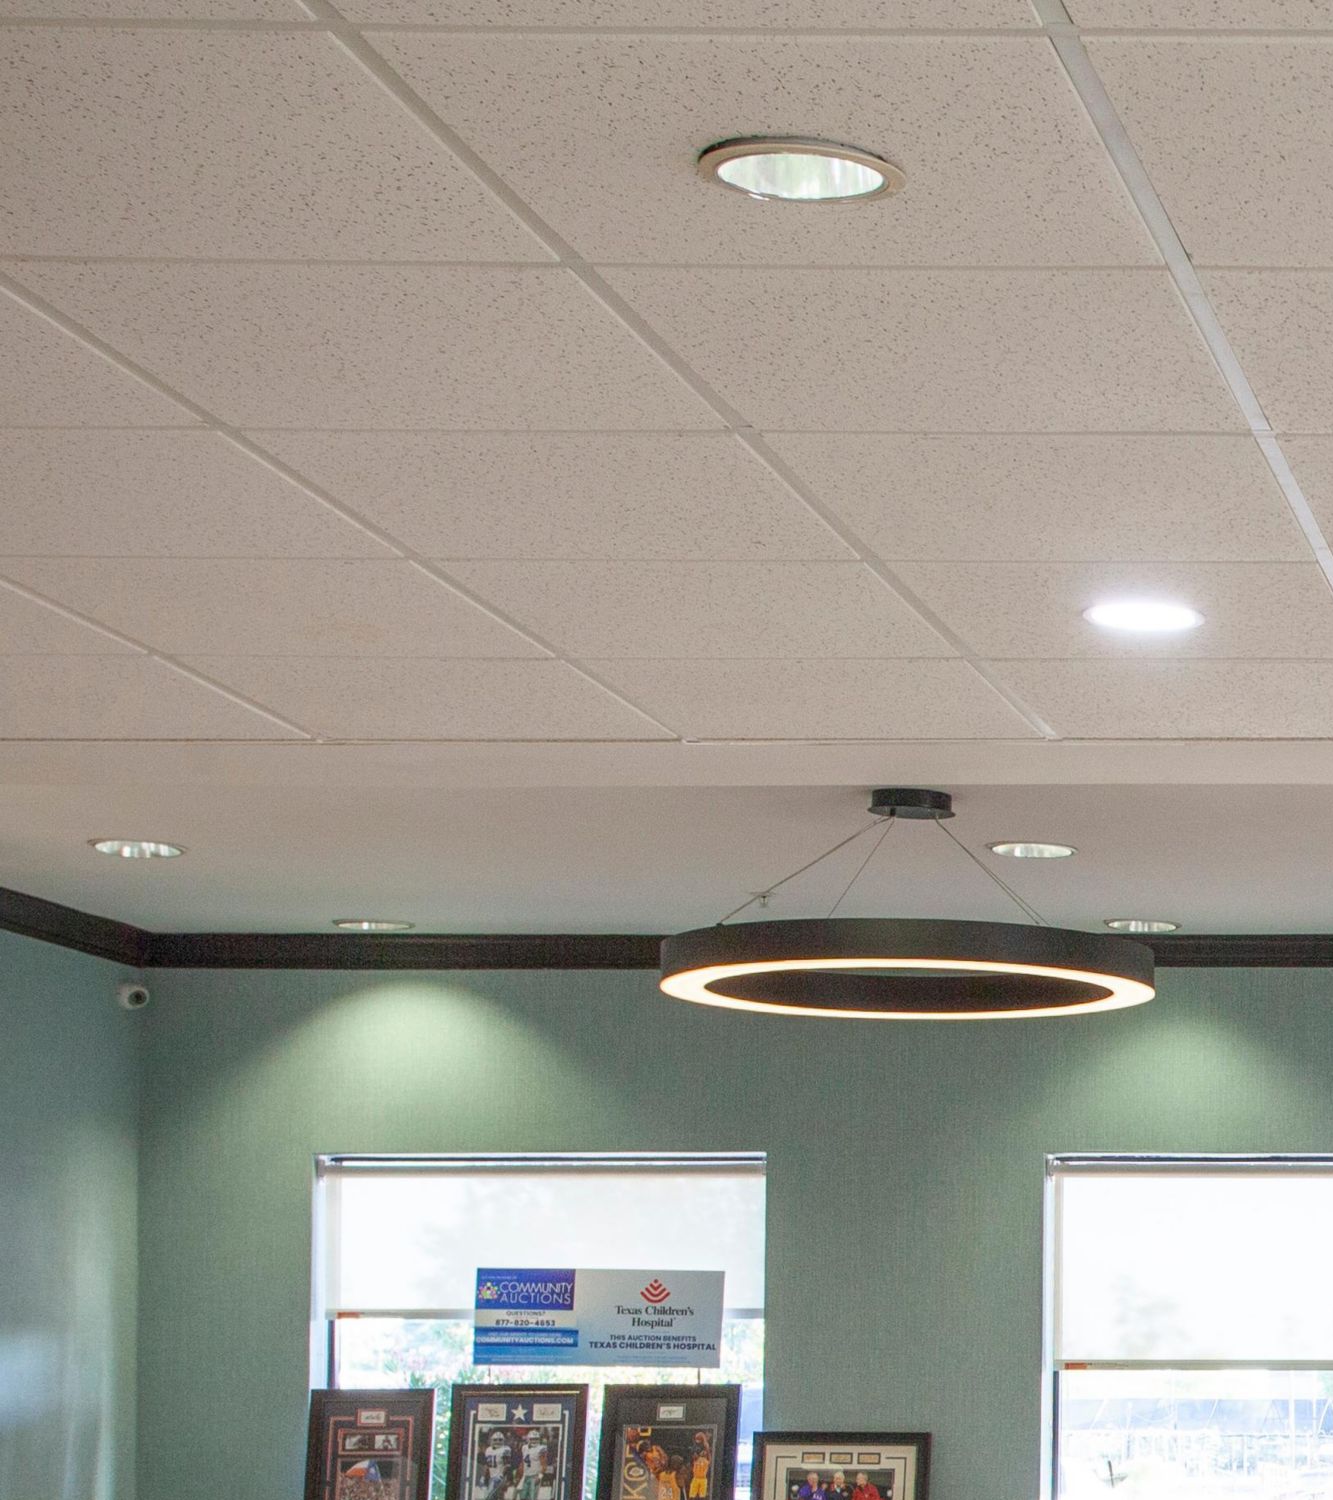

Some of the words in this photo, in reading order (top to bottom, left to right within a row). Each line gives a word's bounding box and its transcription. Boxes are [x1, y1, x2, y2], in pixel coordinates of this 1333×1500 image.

[499, 1281, 574, 1294] COMMUNITY
[499, 1293, 572, 1305] AUCTIONS
[615, 1304, 642, 1316] Texas
[644, 1305, 695, 1317] Children's
[631, 1316, 674, 1330] Hospital
[476, 1336, 574, 1345] COMMUNITYAUCTIONS.COM
[609, 1333, 627, 1341] THIS
[663, 1334, 697, 1342] BENEFITS
[588, 1340, 618, 1350] TEXAS
[618, 1341, 672, 1351] CHILDREN'S
[672, 1342, 717, 1351] HOSPITAL
